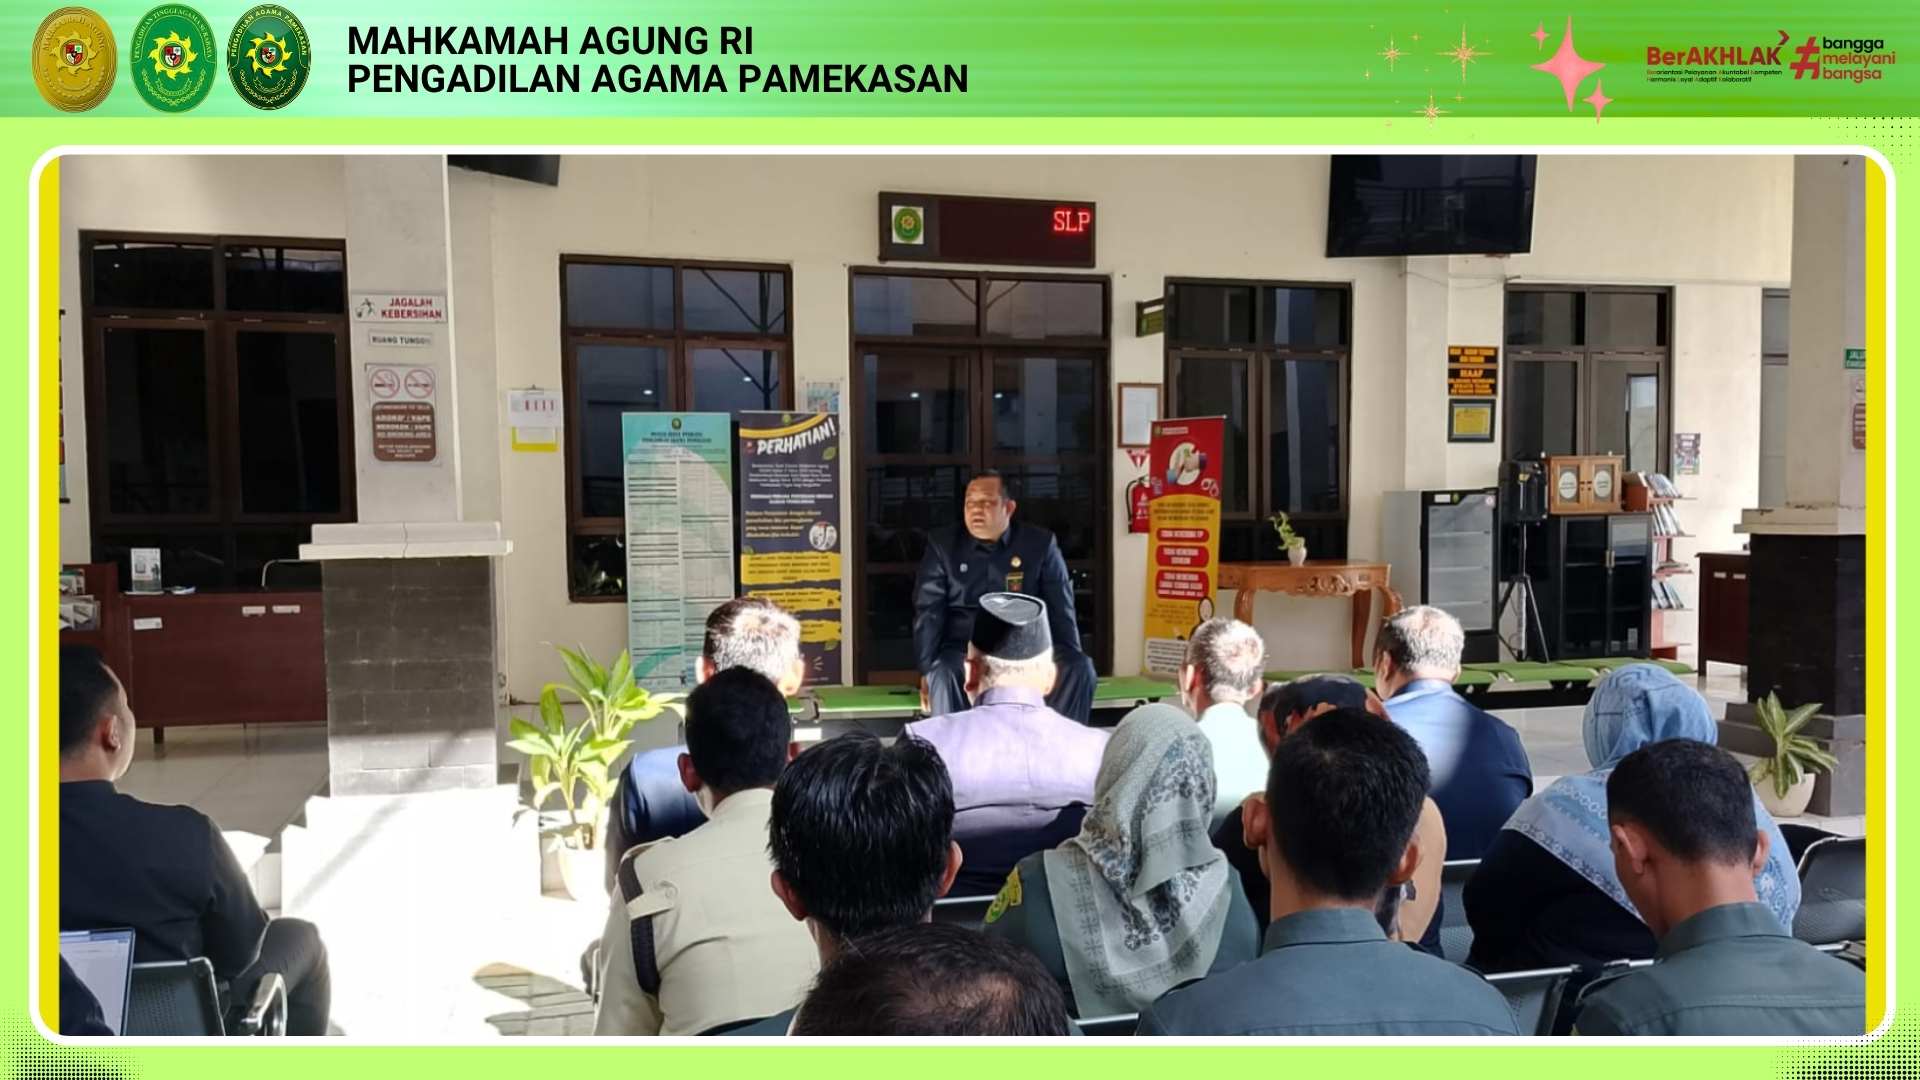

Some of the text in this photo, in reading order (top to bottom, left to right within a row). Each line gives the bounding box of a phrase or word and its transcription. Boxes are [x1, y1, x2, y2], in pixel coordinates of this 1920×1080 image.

[1053, 210, 1090, 232] SLP
[389, 298, 433, 307] JAGALAH
[381, 309, 442, 319] KEBERSIHAN
[372, 335, 398, 344] RUANG
[756, 417, 837, 455] PERHATIAN!
